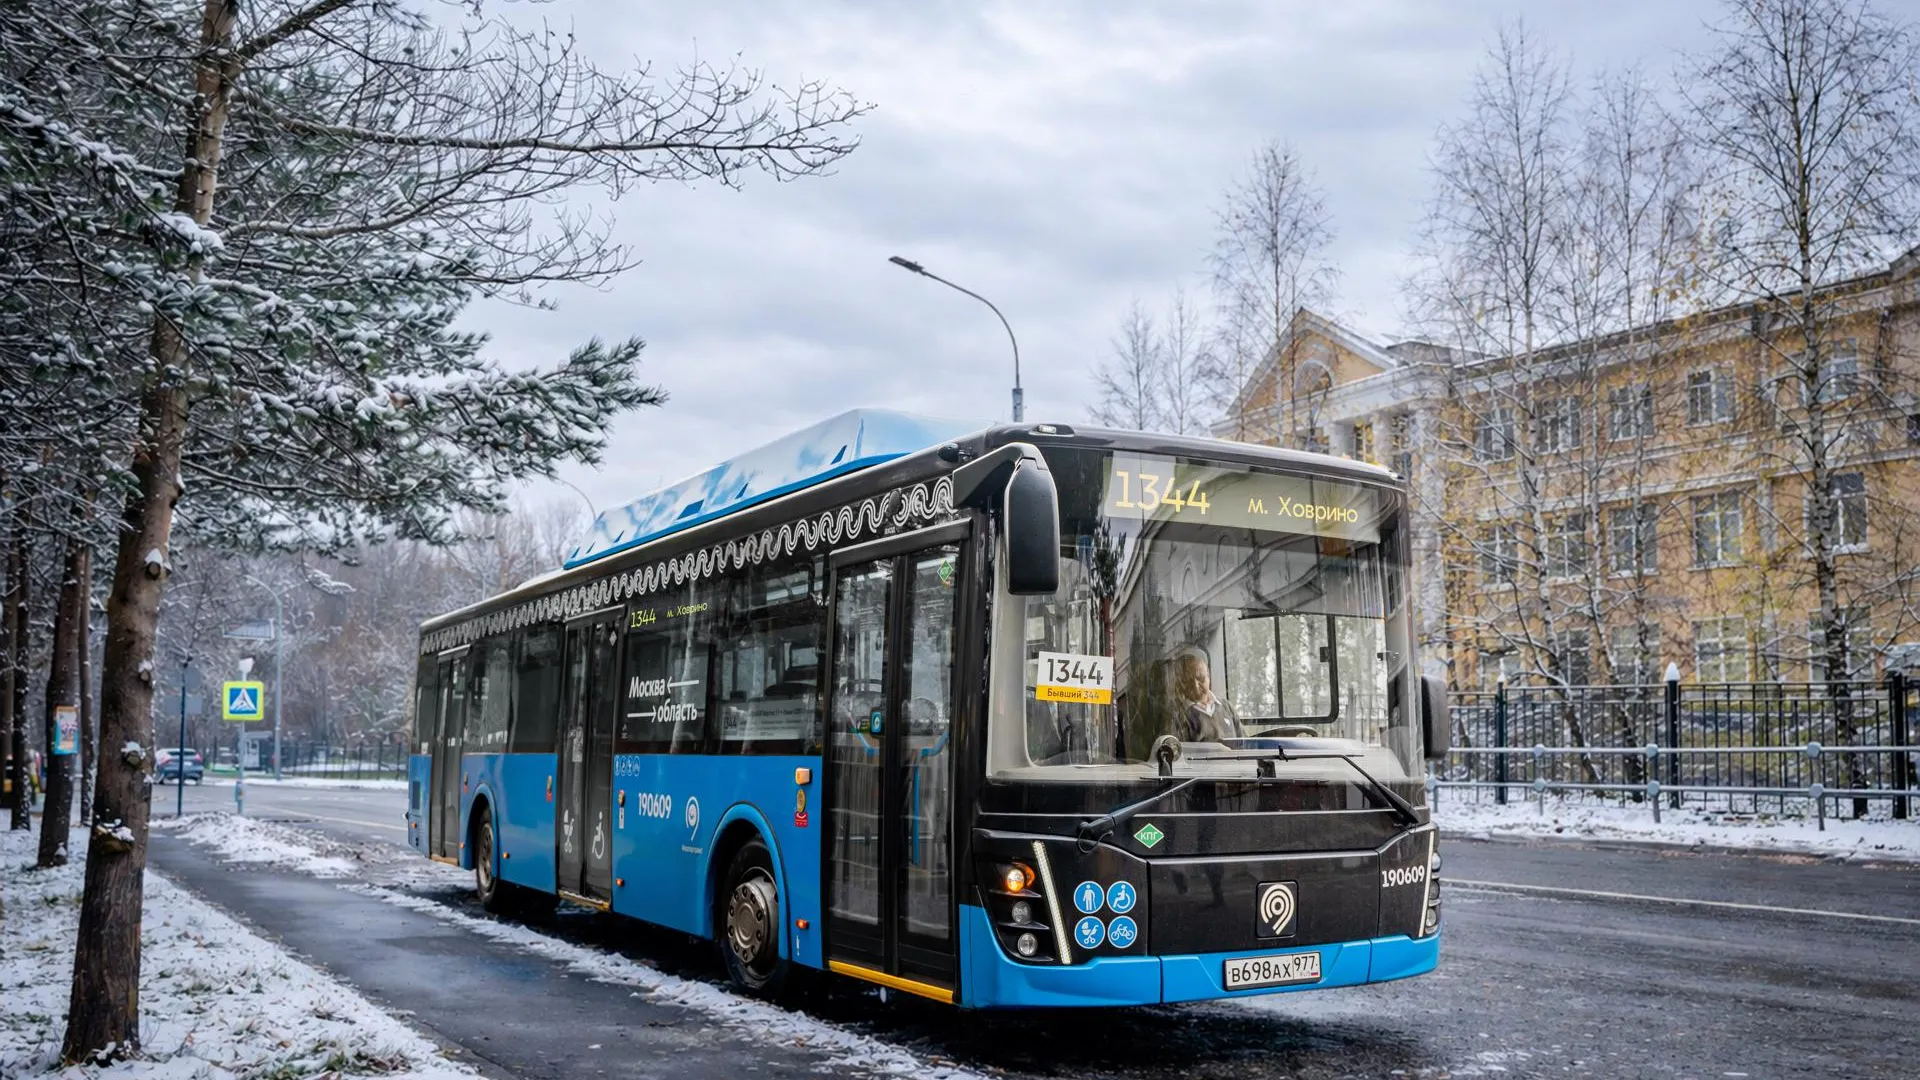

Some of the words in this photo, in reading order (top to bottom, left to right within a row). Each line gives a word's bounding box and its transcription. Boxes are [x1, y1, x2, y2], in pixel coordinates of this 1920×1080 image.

[1115, 470, 1211, 515] 1344
[1247, 498, 1268, 514] м.
[1278, 496, 1359, 523] Ховрино
[631, 607, 657, 628] 1344
[676, 602, 708, 617] Ховрино
[1047, 658, 1104, 685] 1344
[628, 676, 666, 698] Москва
[1047, 687, 1082, 699] Бывший
[1083, 690, 1100, 700] 344
[656, 698, 698, 722] область
[638, 792, 672, 819] 190609
[1140, 831, 1158, 841] КПГ
[1382, 865, 1425, 888] 190609
[1231, 960, 1292, 983] В698АХ
[1293, 955, 1316, 972] 977
